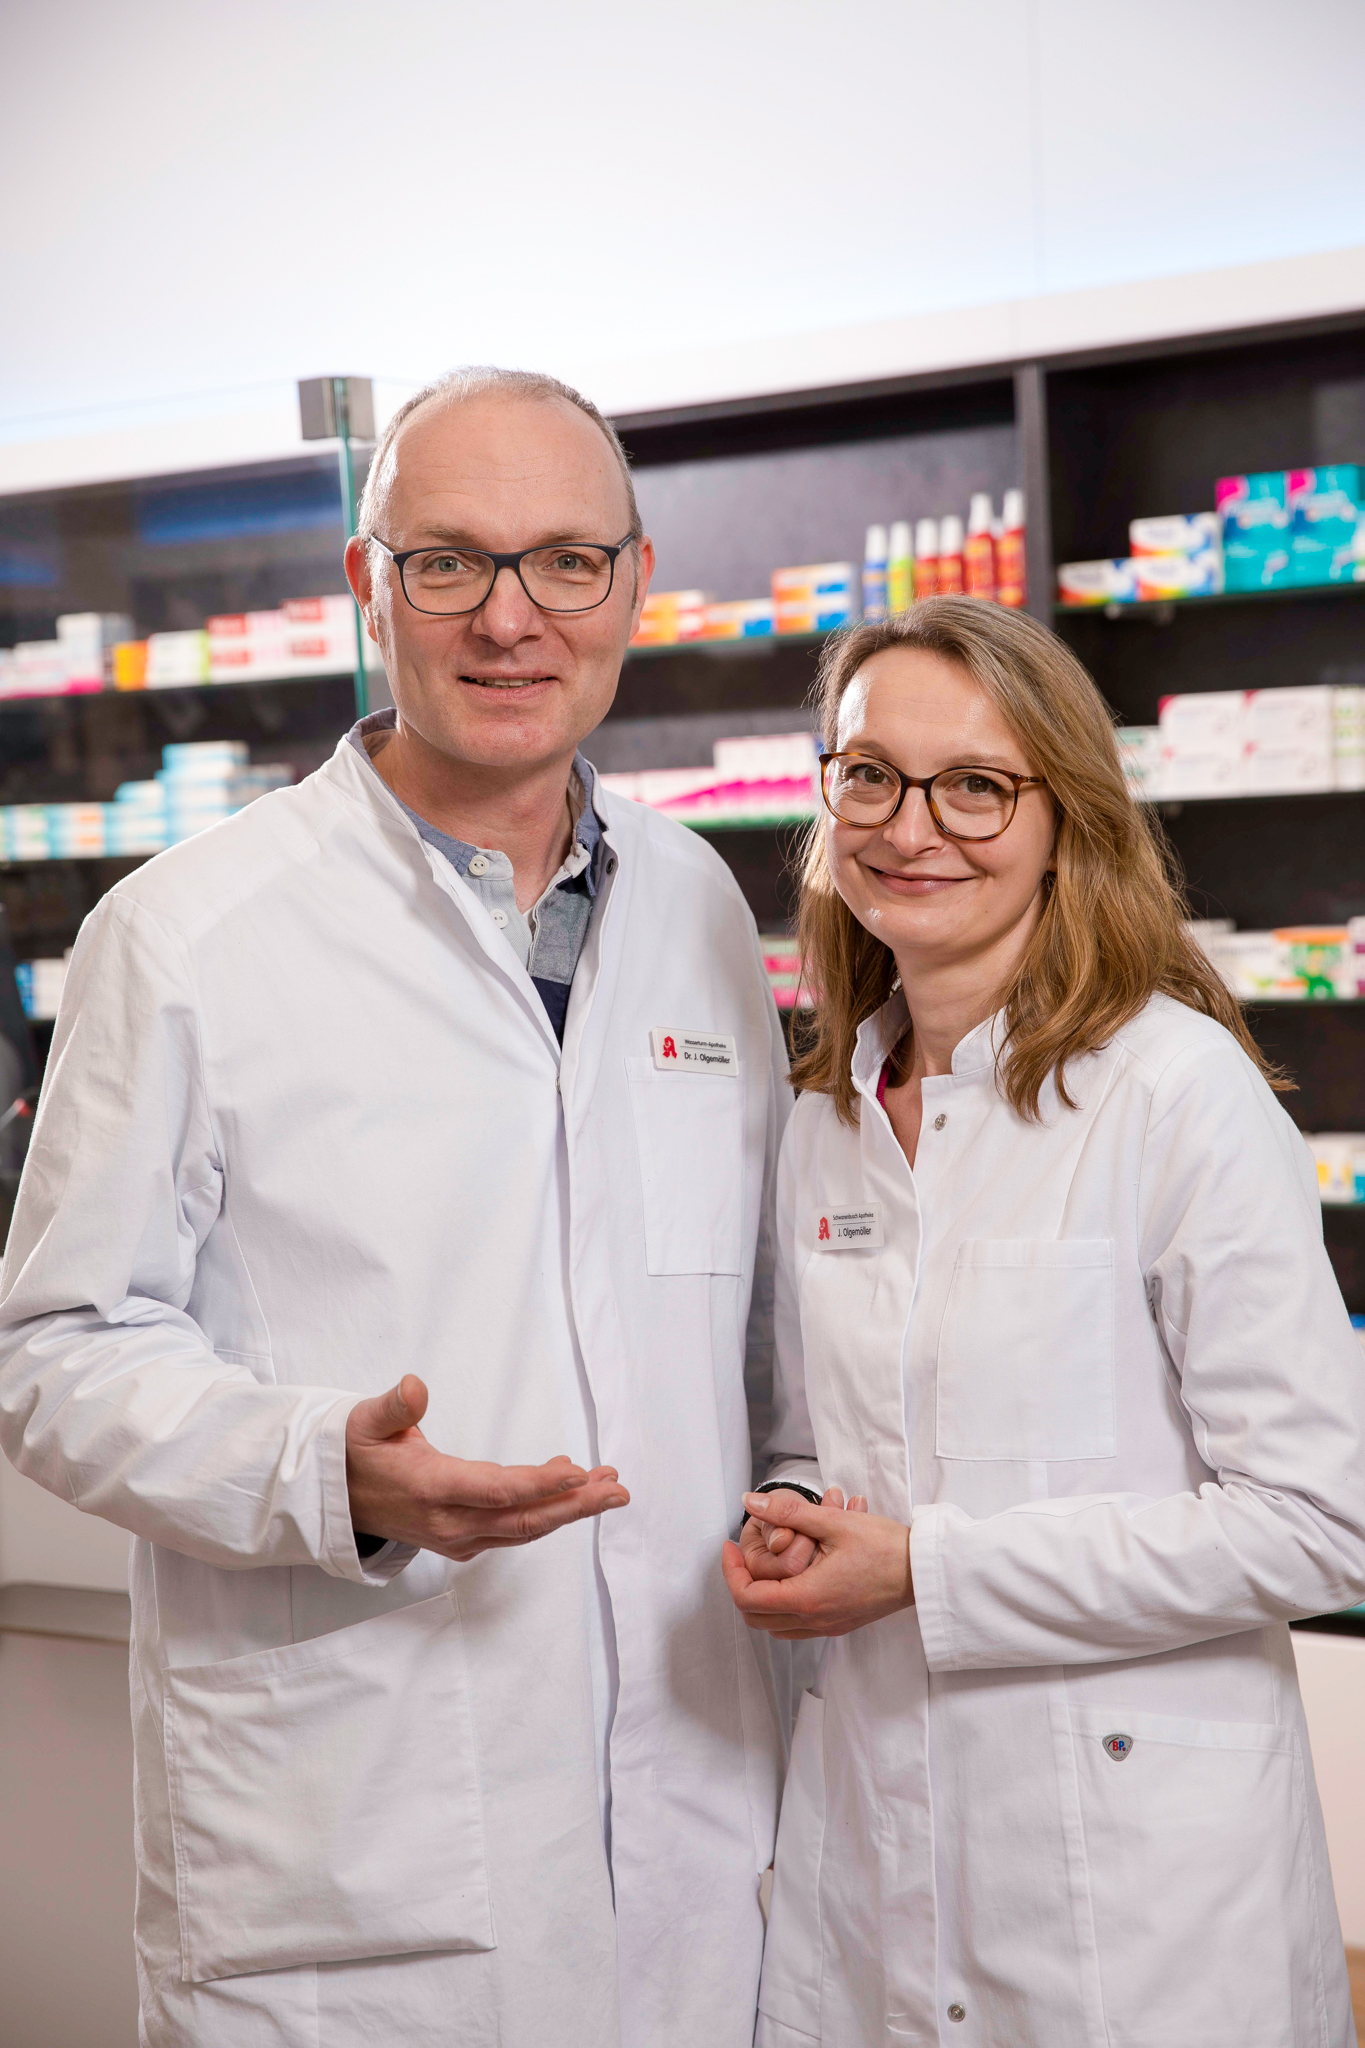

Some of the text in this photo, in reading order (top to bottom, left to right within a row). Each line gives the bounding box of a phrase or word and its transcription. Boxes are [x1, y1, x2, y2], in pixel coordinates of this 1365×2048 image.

[684, 1052, 693, 1060] Dr.
[700, 1053, 730, 1064] Olgemöller
[843, 1226, 872, 1239] Olgemöller
